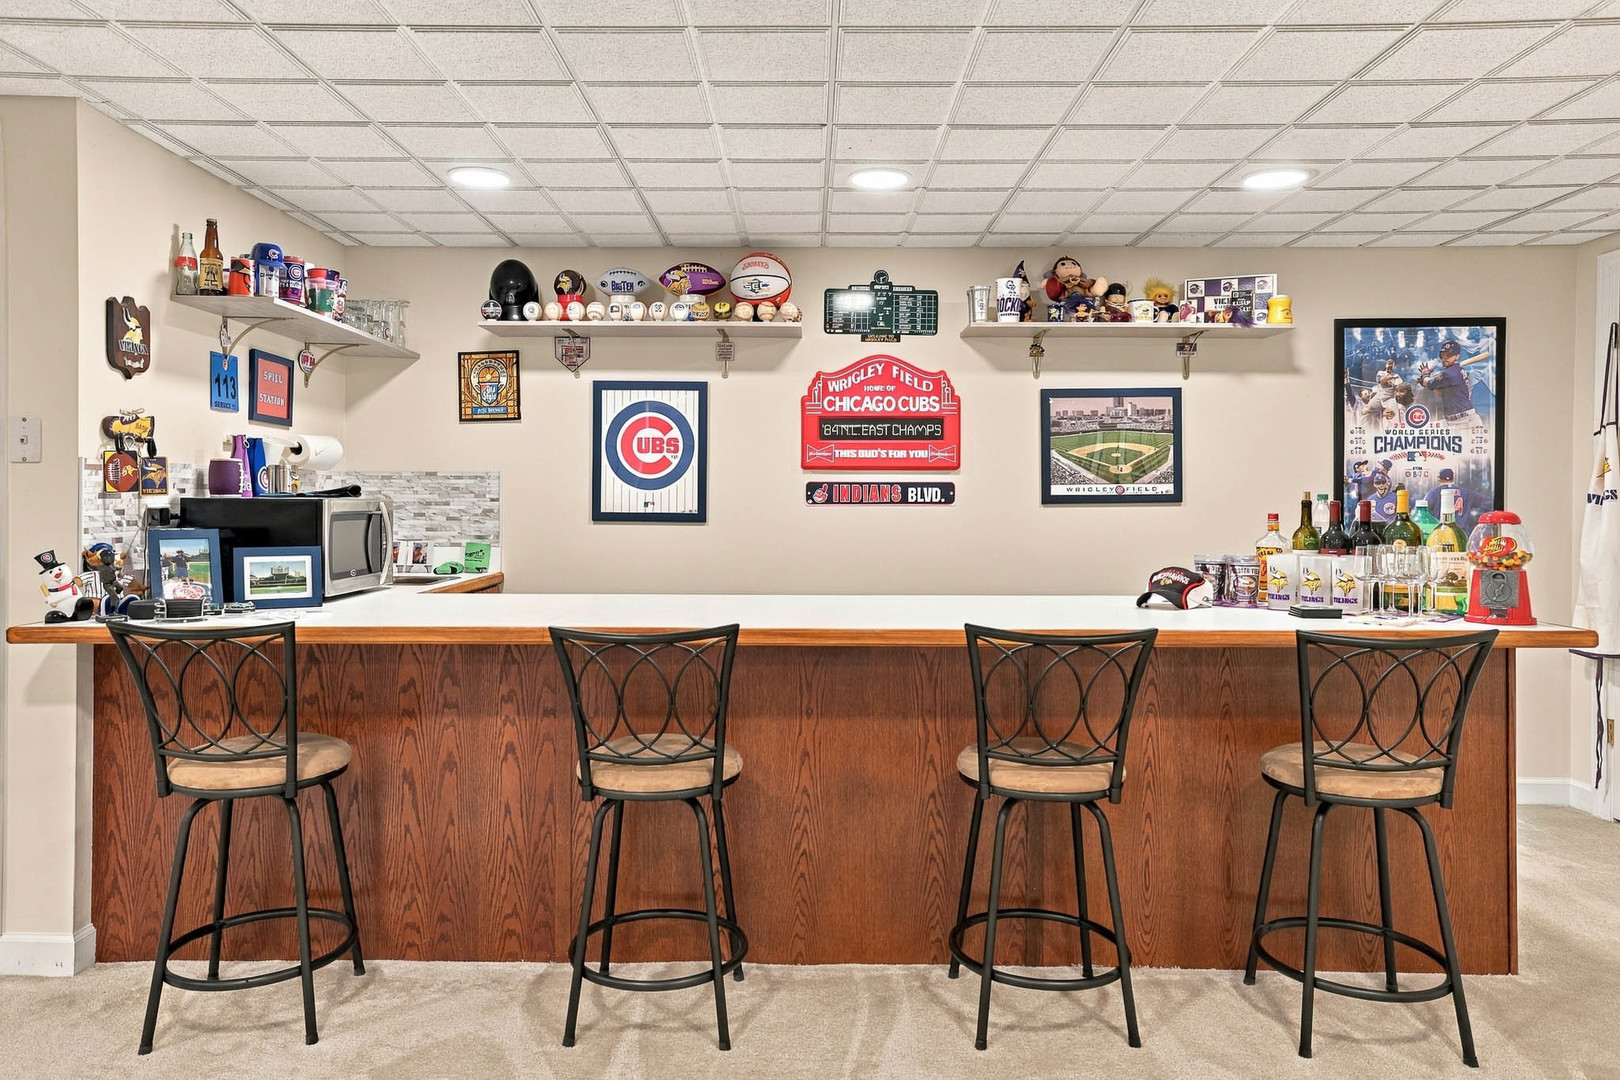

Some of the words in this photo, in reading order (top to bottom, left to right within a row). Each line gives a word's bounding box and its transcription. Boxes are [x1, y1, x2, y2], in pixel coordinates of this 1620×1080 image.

[263, 370, 283, 384] SPILL
[827, 362, 885, 393] WRIGLEY
[892, 365, 934, 392] FIELD
[214, 372, 236, 400] 113
[259, 392, 285, 406] STATION
[823, 396, 896, 412] CHICAGO
[898, 396, 940, 412] CUBS
[862, 424, 890, 436] EAST
[892, 424, 942, 436] CHAMPS
[620, 416, 680, 475] CUBS
[834, 449, 857, 458] THIS
[858, 448, 887, 458] BUD'S
[888, 450, 906, 458] FOR
[908, 449, 929, 458] YOU
[1374, 436, 1462, 454] CHAMPIONS
[832, 483, 902, 503] INDIANS
[908, 487, 945, 503] BLVD.
